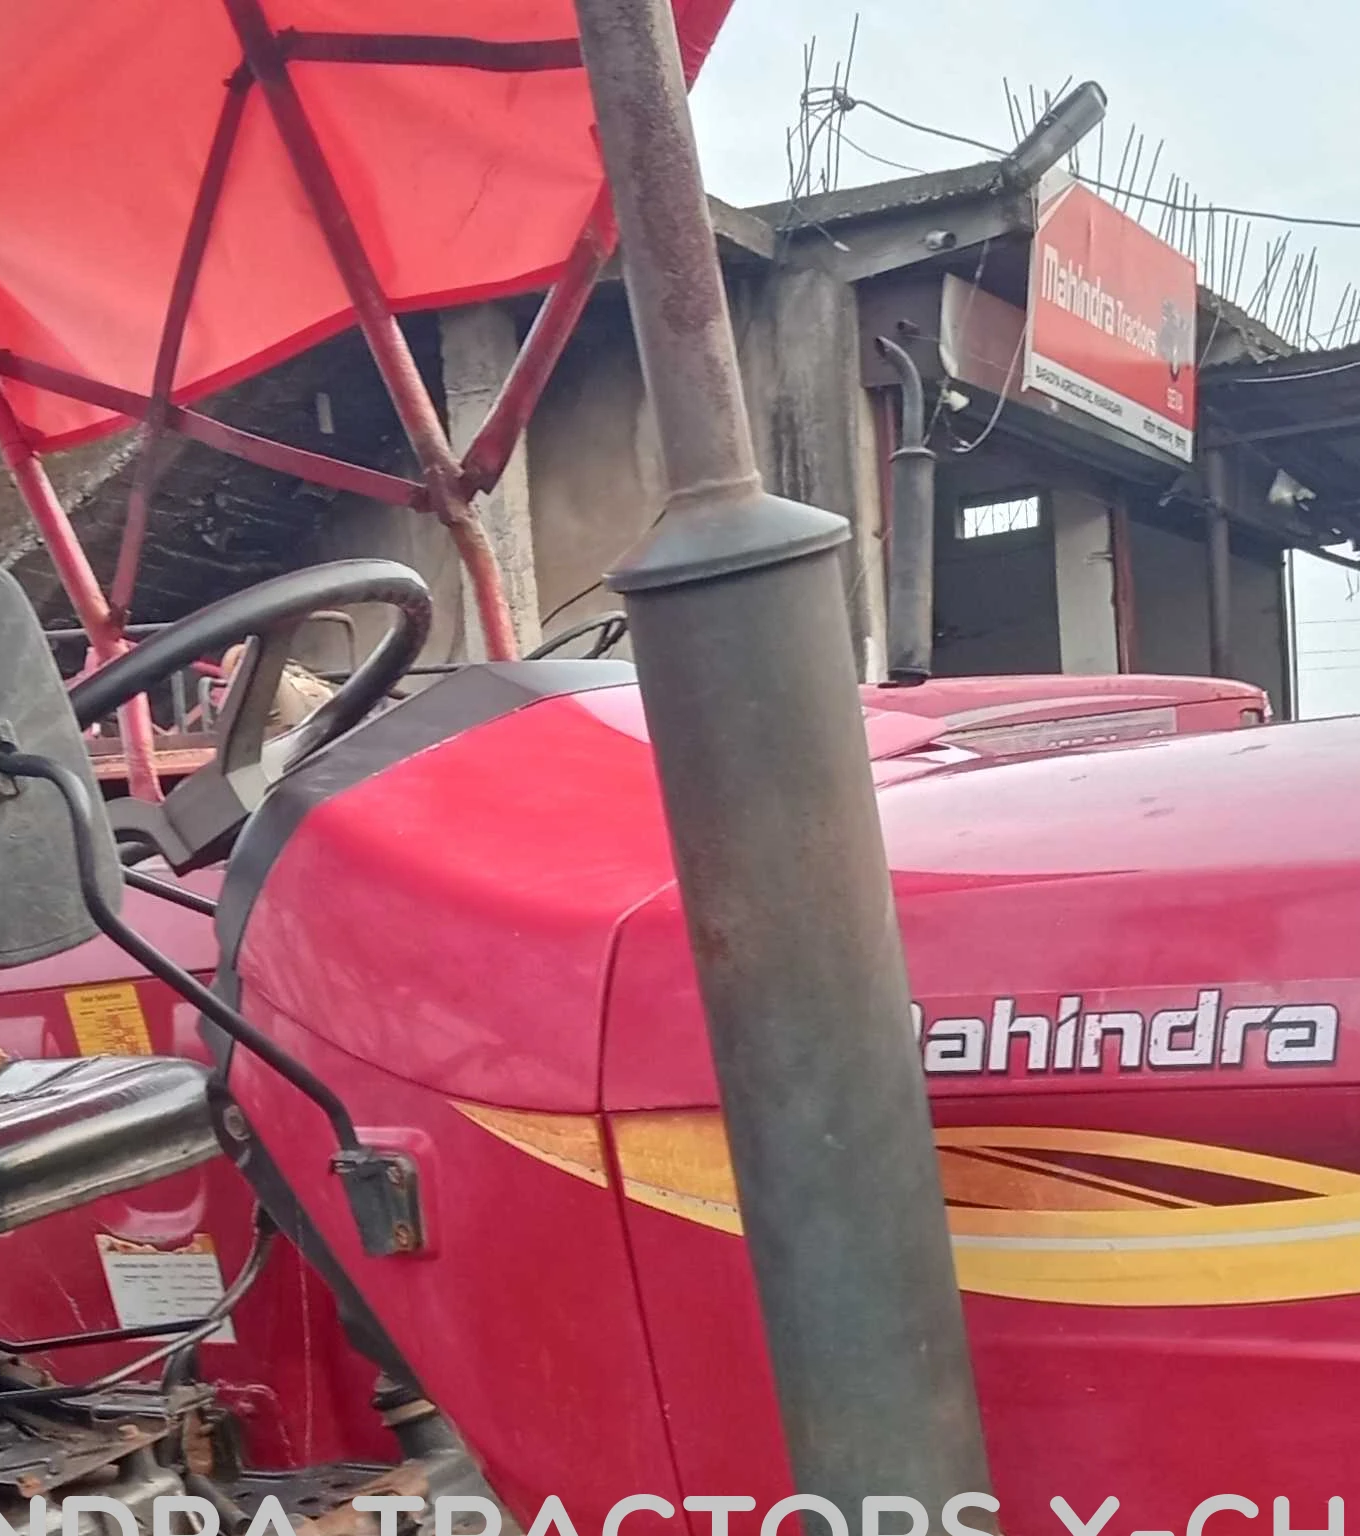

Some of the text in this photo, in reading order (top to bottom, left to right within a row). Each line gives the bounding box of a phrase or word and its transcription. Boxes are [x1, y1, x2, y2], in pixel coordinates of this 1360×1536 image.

[1041, 243, 1157, 357] Mahindra Tractors
[910, 990, 1339, 1075] ahindra
